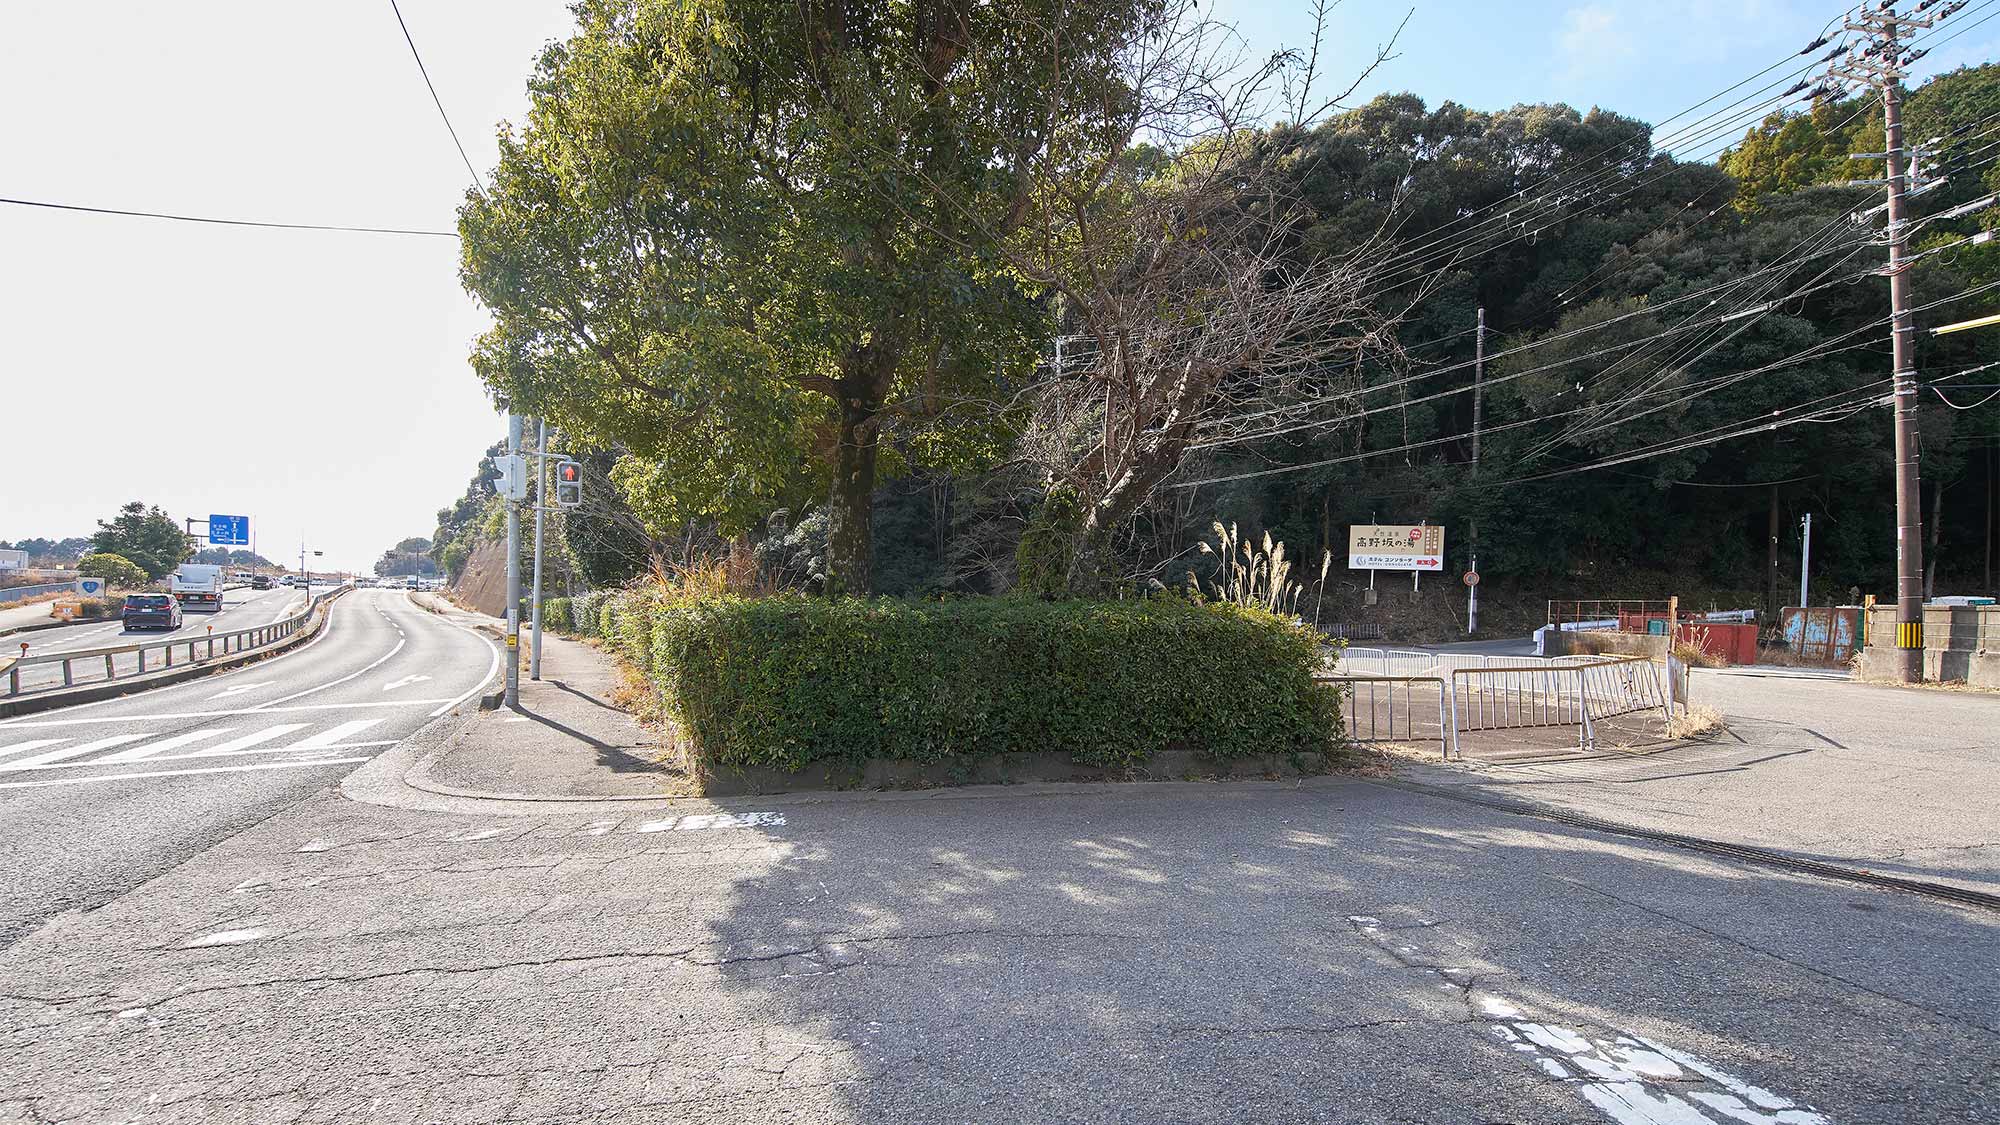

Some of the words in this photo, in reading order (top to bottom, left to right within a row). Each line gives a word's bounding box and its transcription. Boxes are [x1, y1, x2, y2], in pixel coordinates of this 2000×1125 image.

[1357, 537, 1416, 549] 高野坂の湯
